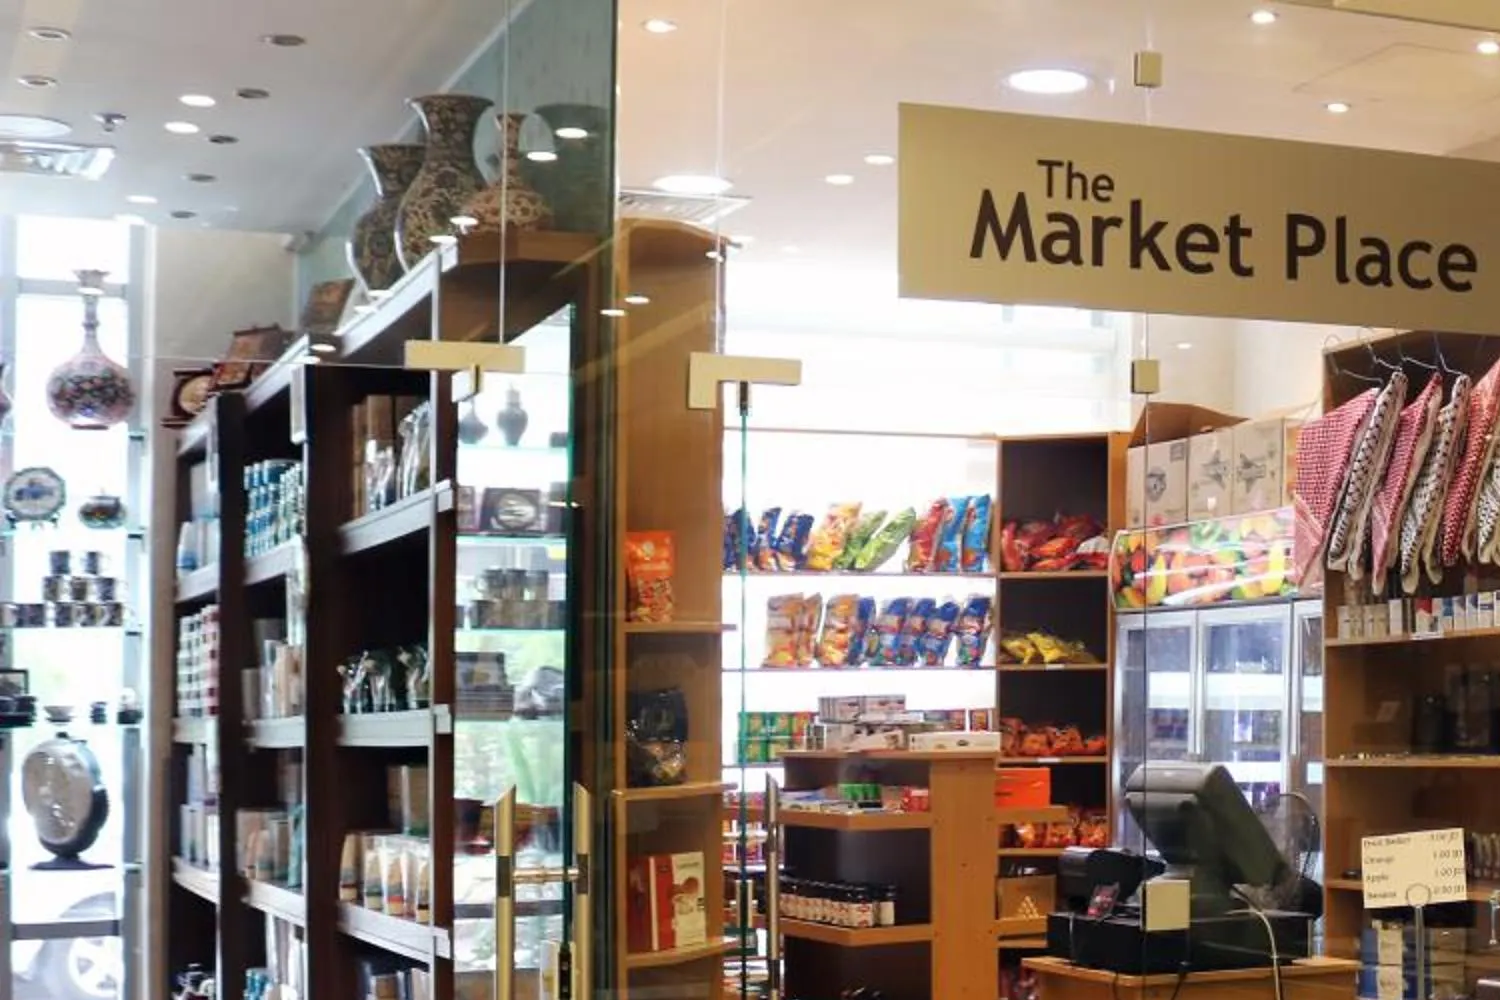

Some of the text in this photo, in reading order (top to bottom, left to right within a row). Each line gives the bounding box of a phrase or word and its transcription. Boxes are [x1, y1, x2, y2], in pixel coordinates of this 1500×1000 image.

[1037, 159, 1115, 202] The
[970, 189, 1478, 292] Market Place
